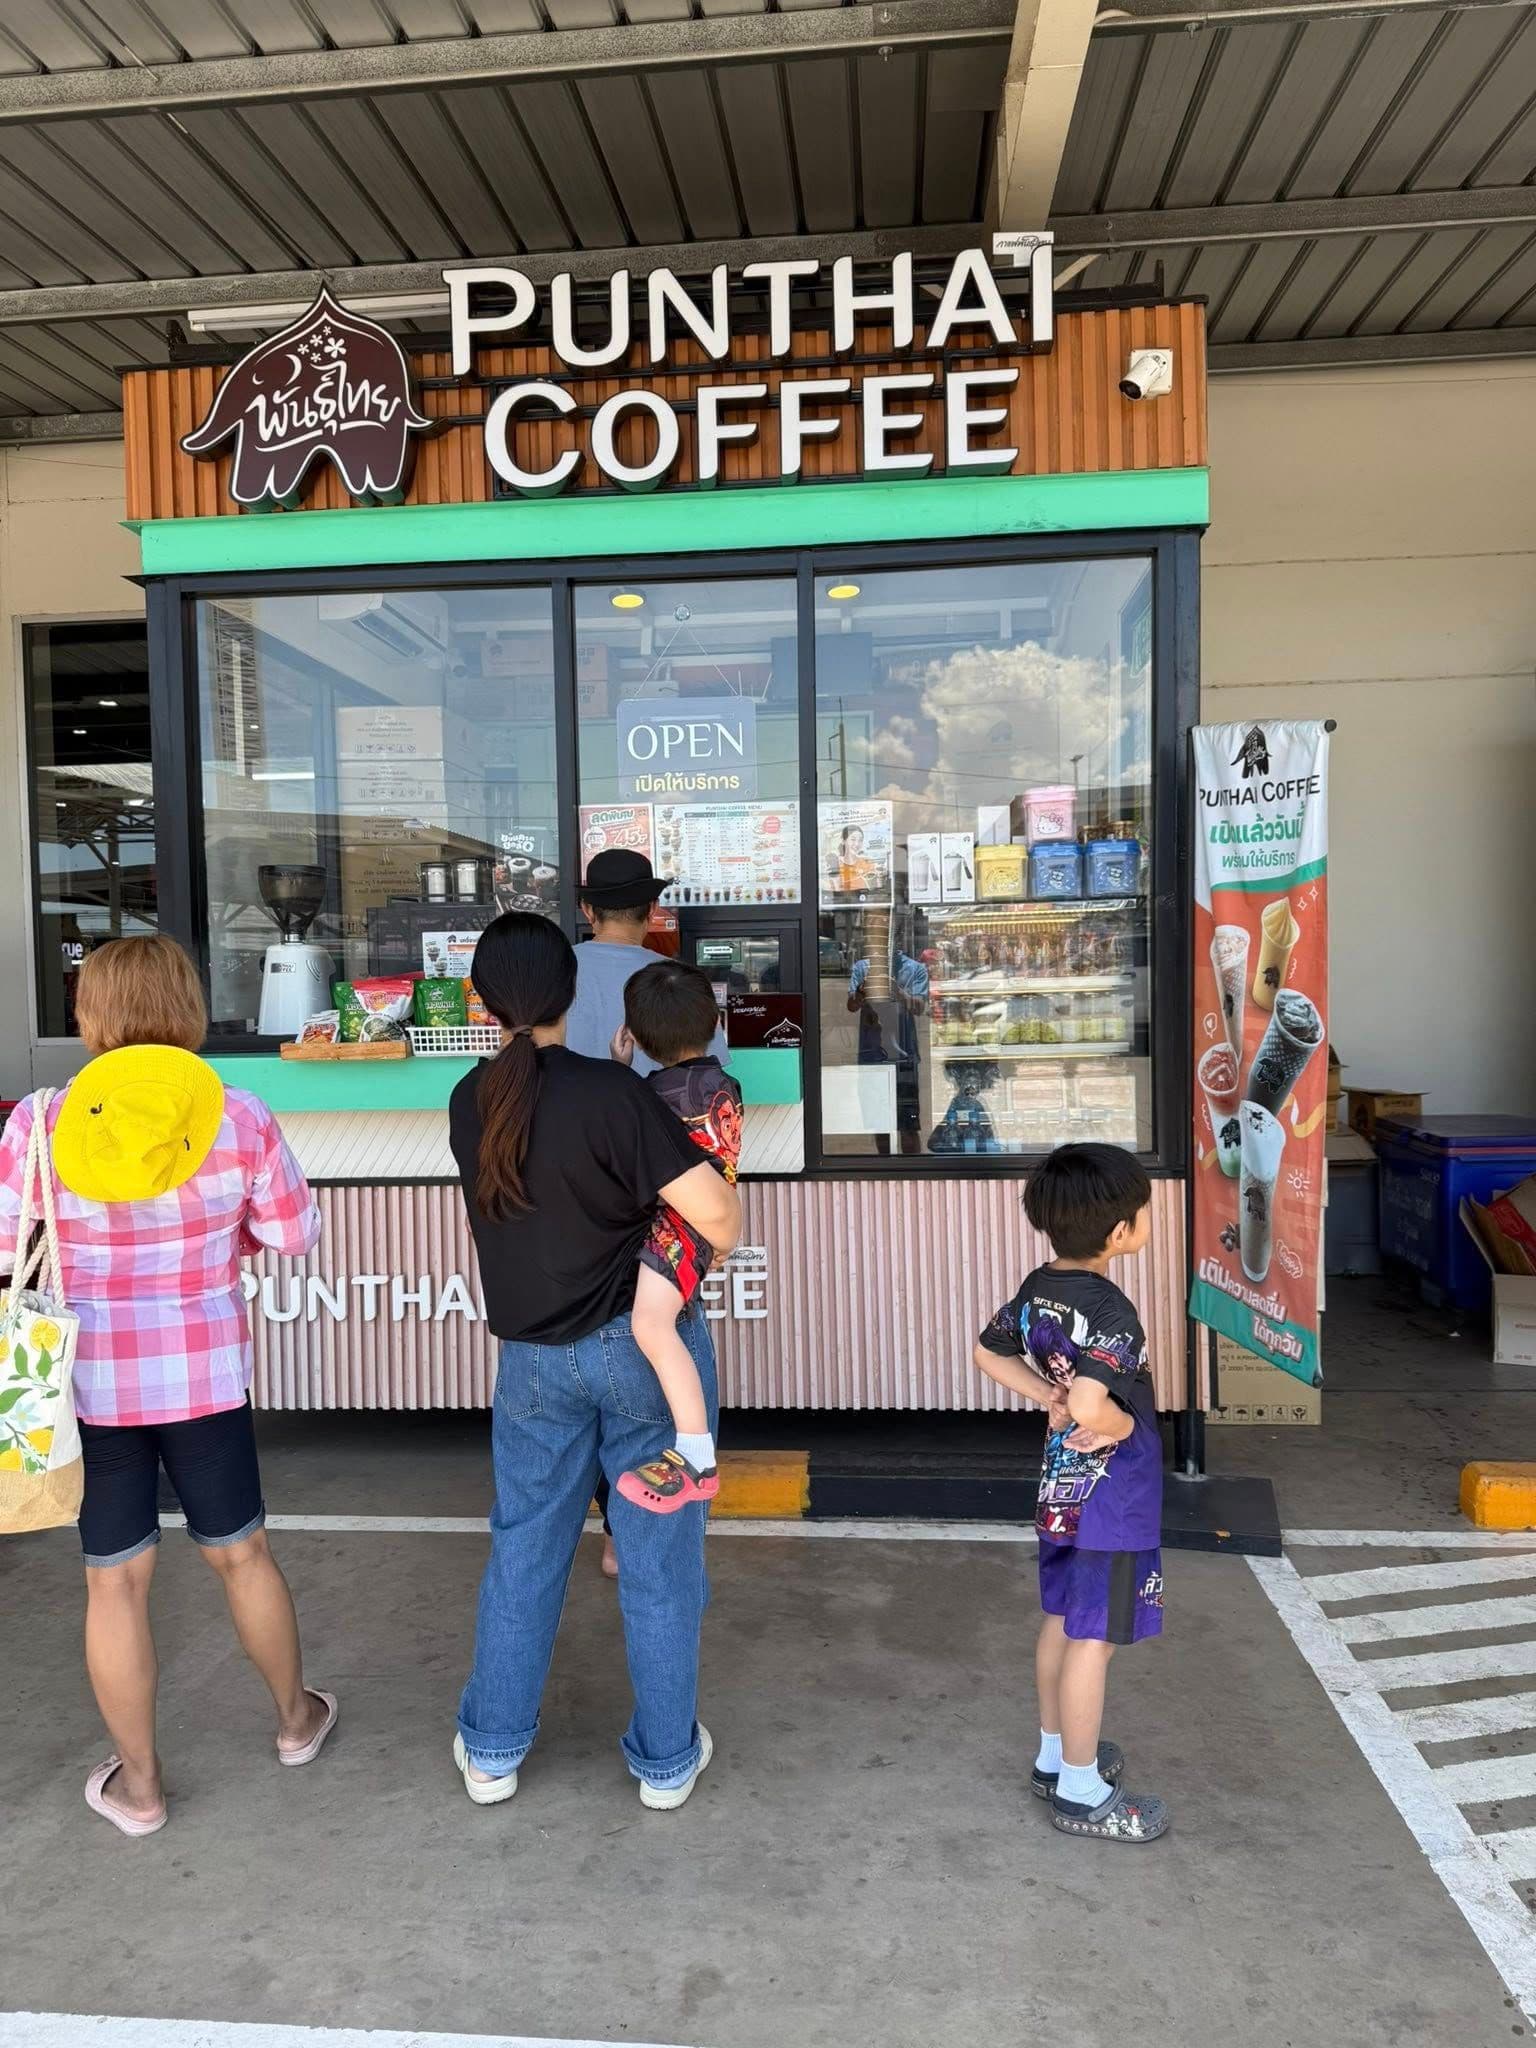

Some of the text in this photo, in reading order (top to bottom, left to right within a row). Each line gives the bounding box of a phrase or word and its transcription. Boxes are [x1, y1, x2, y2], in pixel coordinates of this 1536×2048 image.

[441, 245, 1054, 376] PUNTHAI
[484, 367, 1020, 488] COFFEE
[627, 721, 744, 760] OPEN
[635, 772, 740, 792] เปิดให้บริการ
[242, 1270, 488, 1323] PUNTHA
